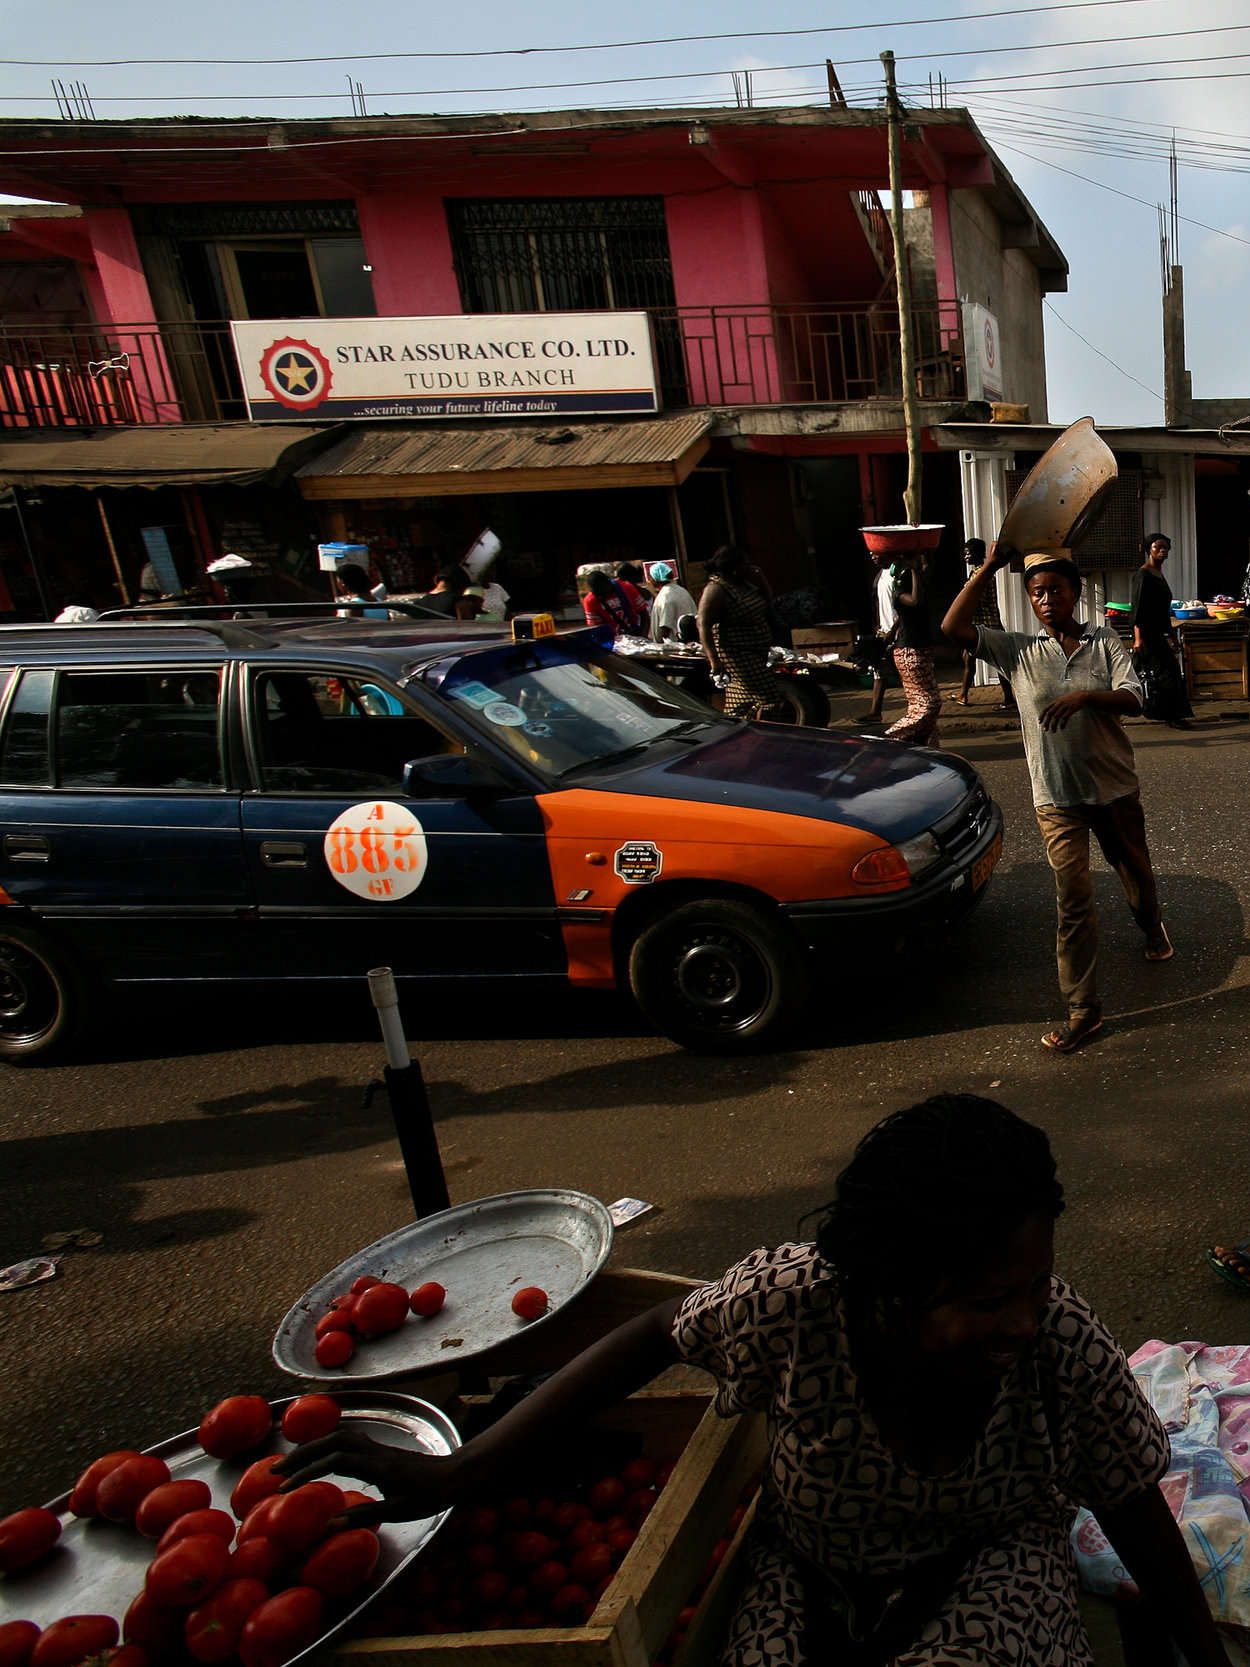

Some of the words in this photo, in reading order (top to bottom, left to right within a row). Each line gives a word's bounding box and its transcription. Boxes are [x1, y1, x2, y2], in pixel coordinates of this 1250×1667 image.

[336, 345, 396, 363] STAR
[401, 342, 536, 361] ASSURANCE
[541, 340, 580, 359] CO.
[586, 339, 636, 357] LTD.
[404, 372, 469, 389] TUDU
[477, 369, 576, 387] BRANCH
[416, 404, 442, 415] your
[445, 402, 480, 415] future
[483, 401, 523, 413] lifeline
[526, 400, 558, 412] today
[535, 619, 553, 637] TAXI
[366, 804, 385, 820] A
[330, 826, 419, 874] 885
